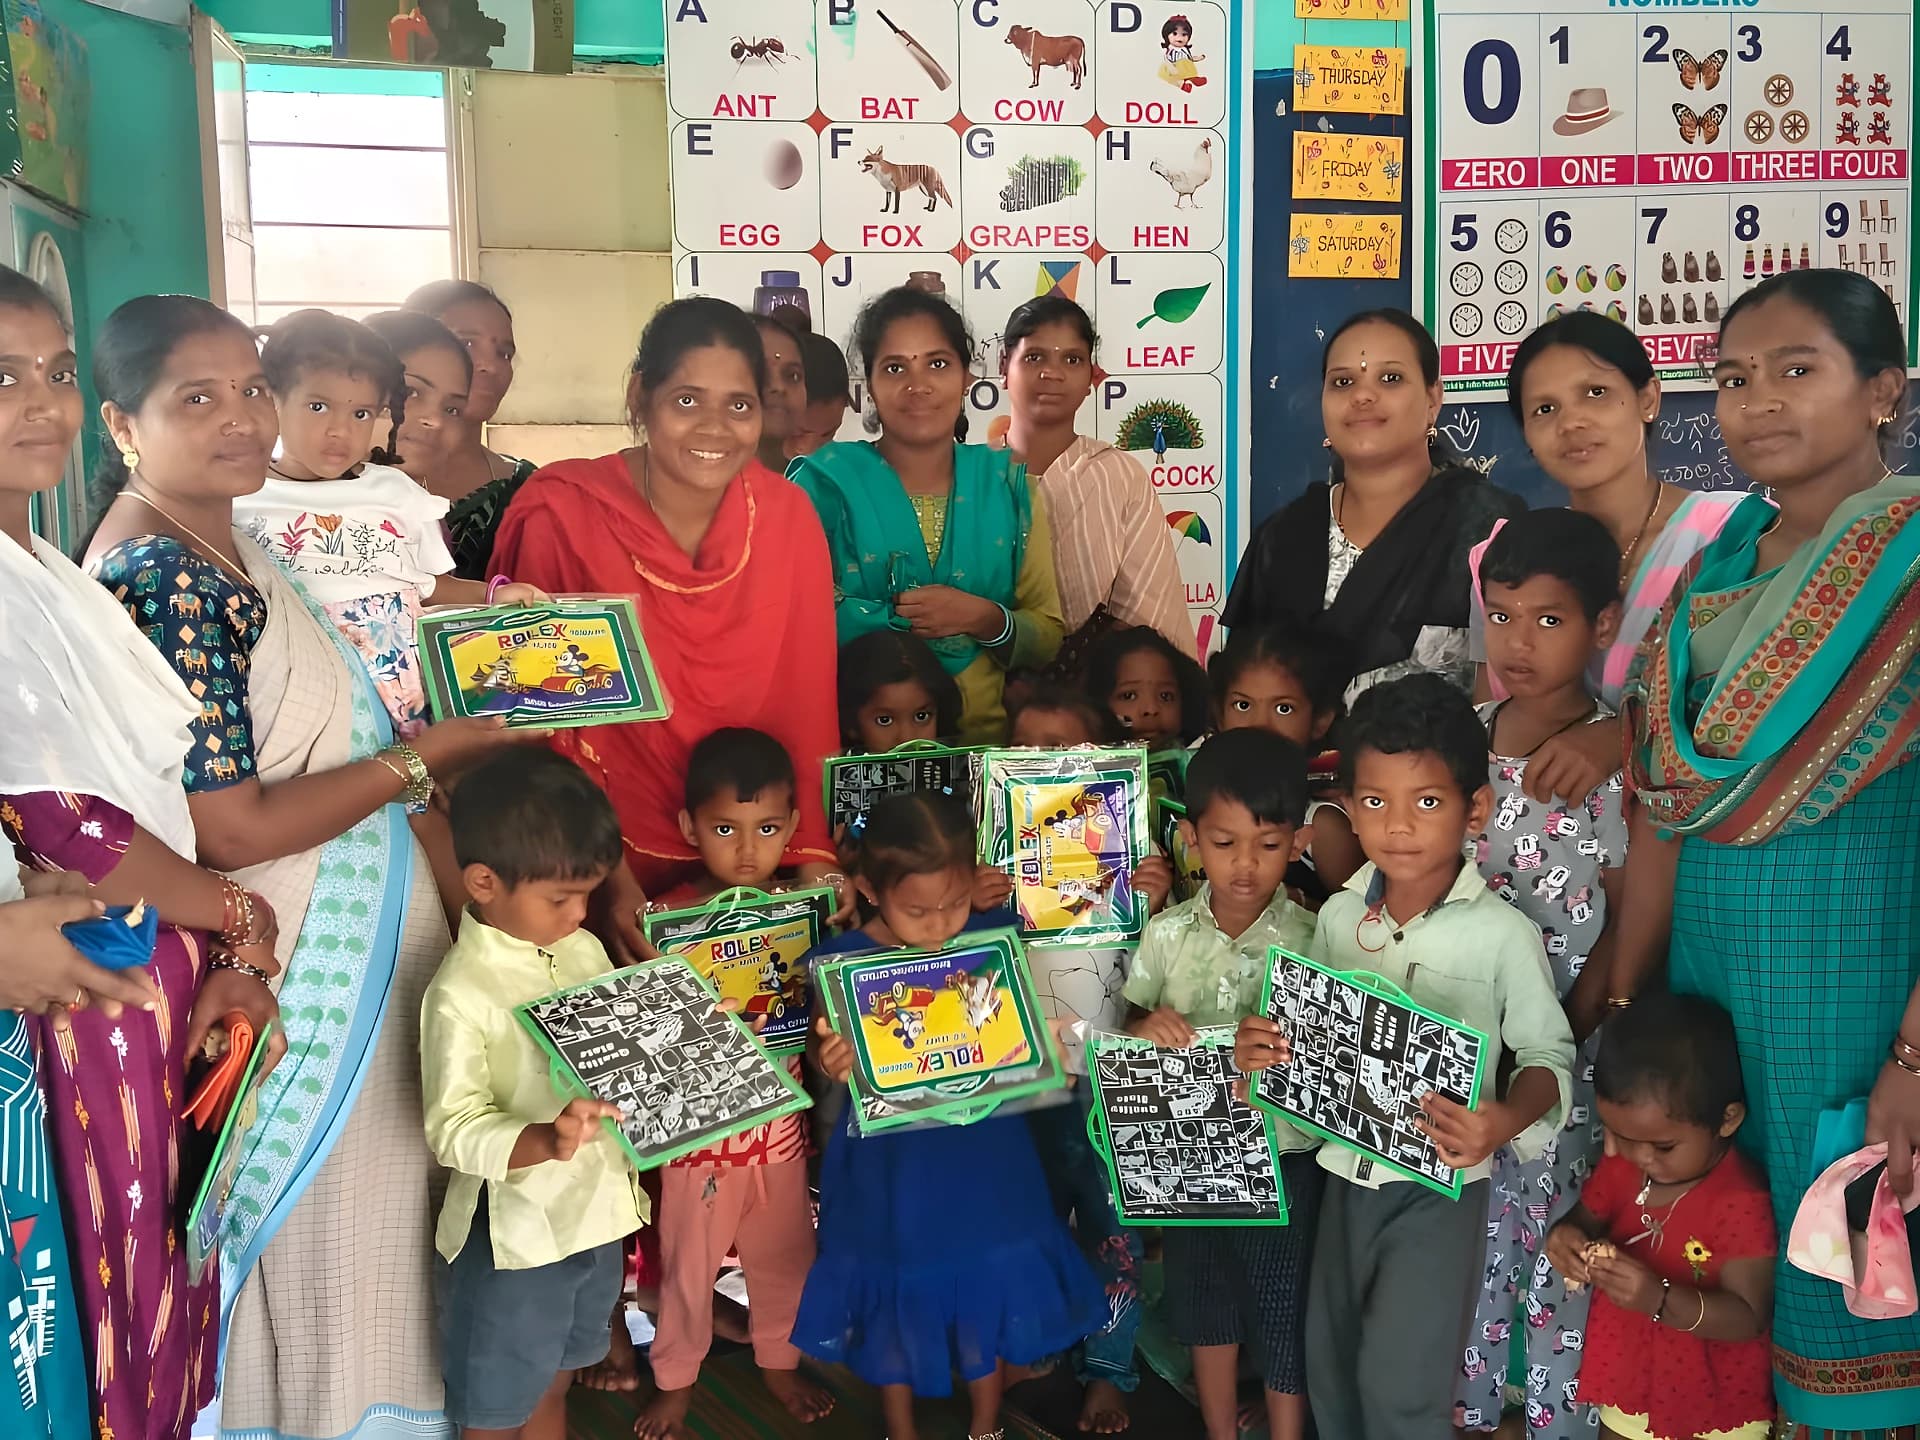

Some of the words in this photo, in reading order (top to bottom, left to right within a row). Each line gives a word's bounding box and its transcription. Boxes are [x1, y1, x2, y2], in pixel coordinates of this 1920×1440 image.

[676, 0, 707, 23] A
[828, 0, 854, 26] B
[972, 0, 998, 27] C
[1110, 2, 1142, 33] D
[1550, 25, 1569, 64] 1
[1643, 25, 1670, 63] 2
[1737, 24, 1763, 62] 3
[1825, 25, 1852, 61] 4
[1319, 67, 1386, 86] THURSDAY
[1463, 39, 1522, 125] 0
[713, 93, 777, 118] ANT
[861, 97, 919, 120] BAT
[994, 99, 1064, 122] COW
[1126, 101, 1198, 125] DOLL
[687, 123, 714, 156] E
[831, 127, 853, 159] F
[966, 127, 994, 157] G
[1106, 131, 1131, 160] H
[1322, 160, 1372, 177] FRIDAY
[1454, 161, 1526, 187] ZERO
[1560, 158, 1617, 184] ONE
[1653, 156, 1713, 181] TWO
[1735, 153, 1816, 179] THREE
[1830, 151, 1898, 177] FOUR
[1450, 213, 1478, 252] 5
[1544, 210, 1572, 249] 6
[1641, 208, 1668, 244] 7
[1734, 204, 1761, 242] 8
[1825, 201, 1850, 238] 9
[719, 223, 781, 247] EGG
[863, 224, 923, 248] FOX
[970, 225, 1089, 248] GRAPES
[1133, 225, 1189, 248] HEN
[1318, 235, 1384, 251] SATURDAY
[691, 255, 699, 286] I
[831, 259, 852, 287] J
[974, 259, 1001, 289] K
[1110, 255, 1131, 285] L
[1126, 345, 1195, 368] LEAF
[1458, 344, 1518, 372] FIVE
[970, 380, 999, 411] O
[1104, 381, 1127, 410] P
[1150, 464, 1215, 487] COCK
[498, 623, 568, 649] ROLEX
[711, 934, 775, 962] ROLEX
[1370, 1002, 1388, 1051] Quality
[578, 1048, 630, 1069] Quality
[914, 1042, 984, 1075] ROLEX
[1110, 1105, 1158, 1115] Quality
